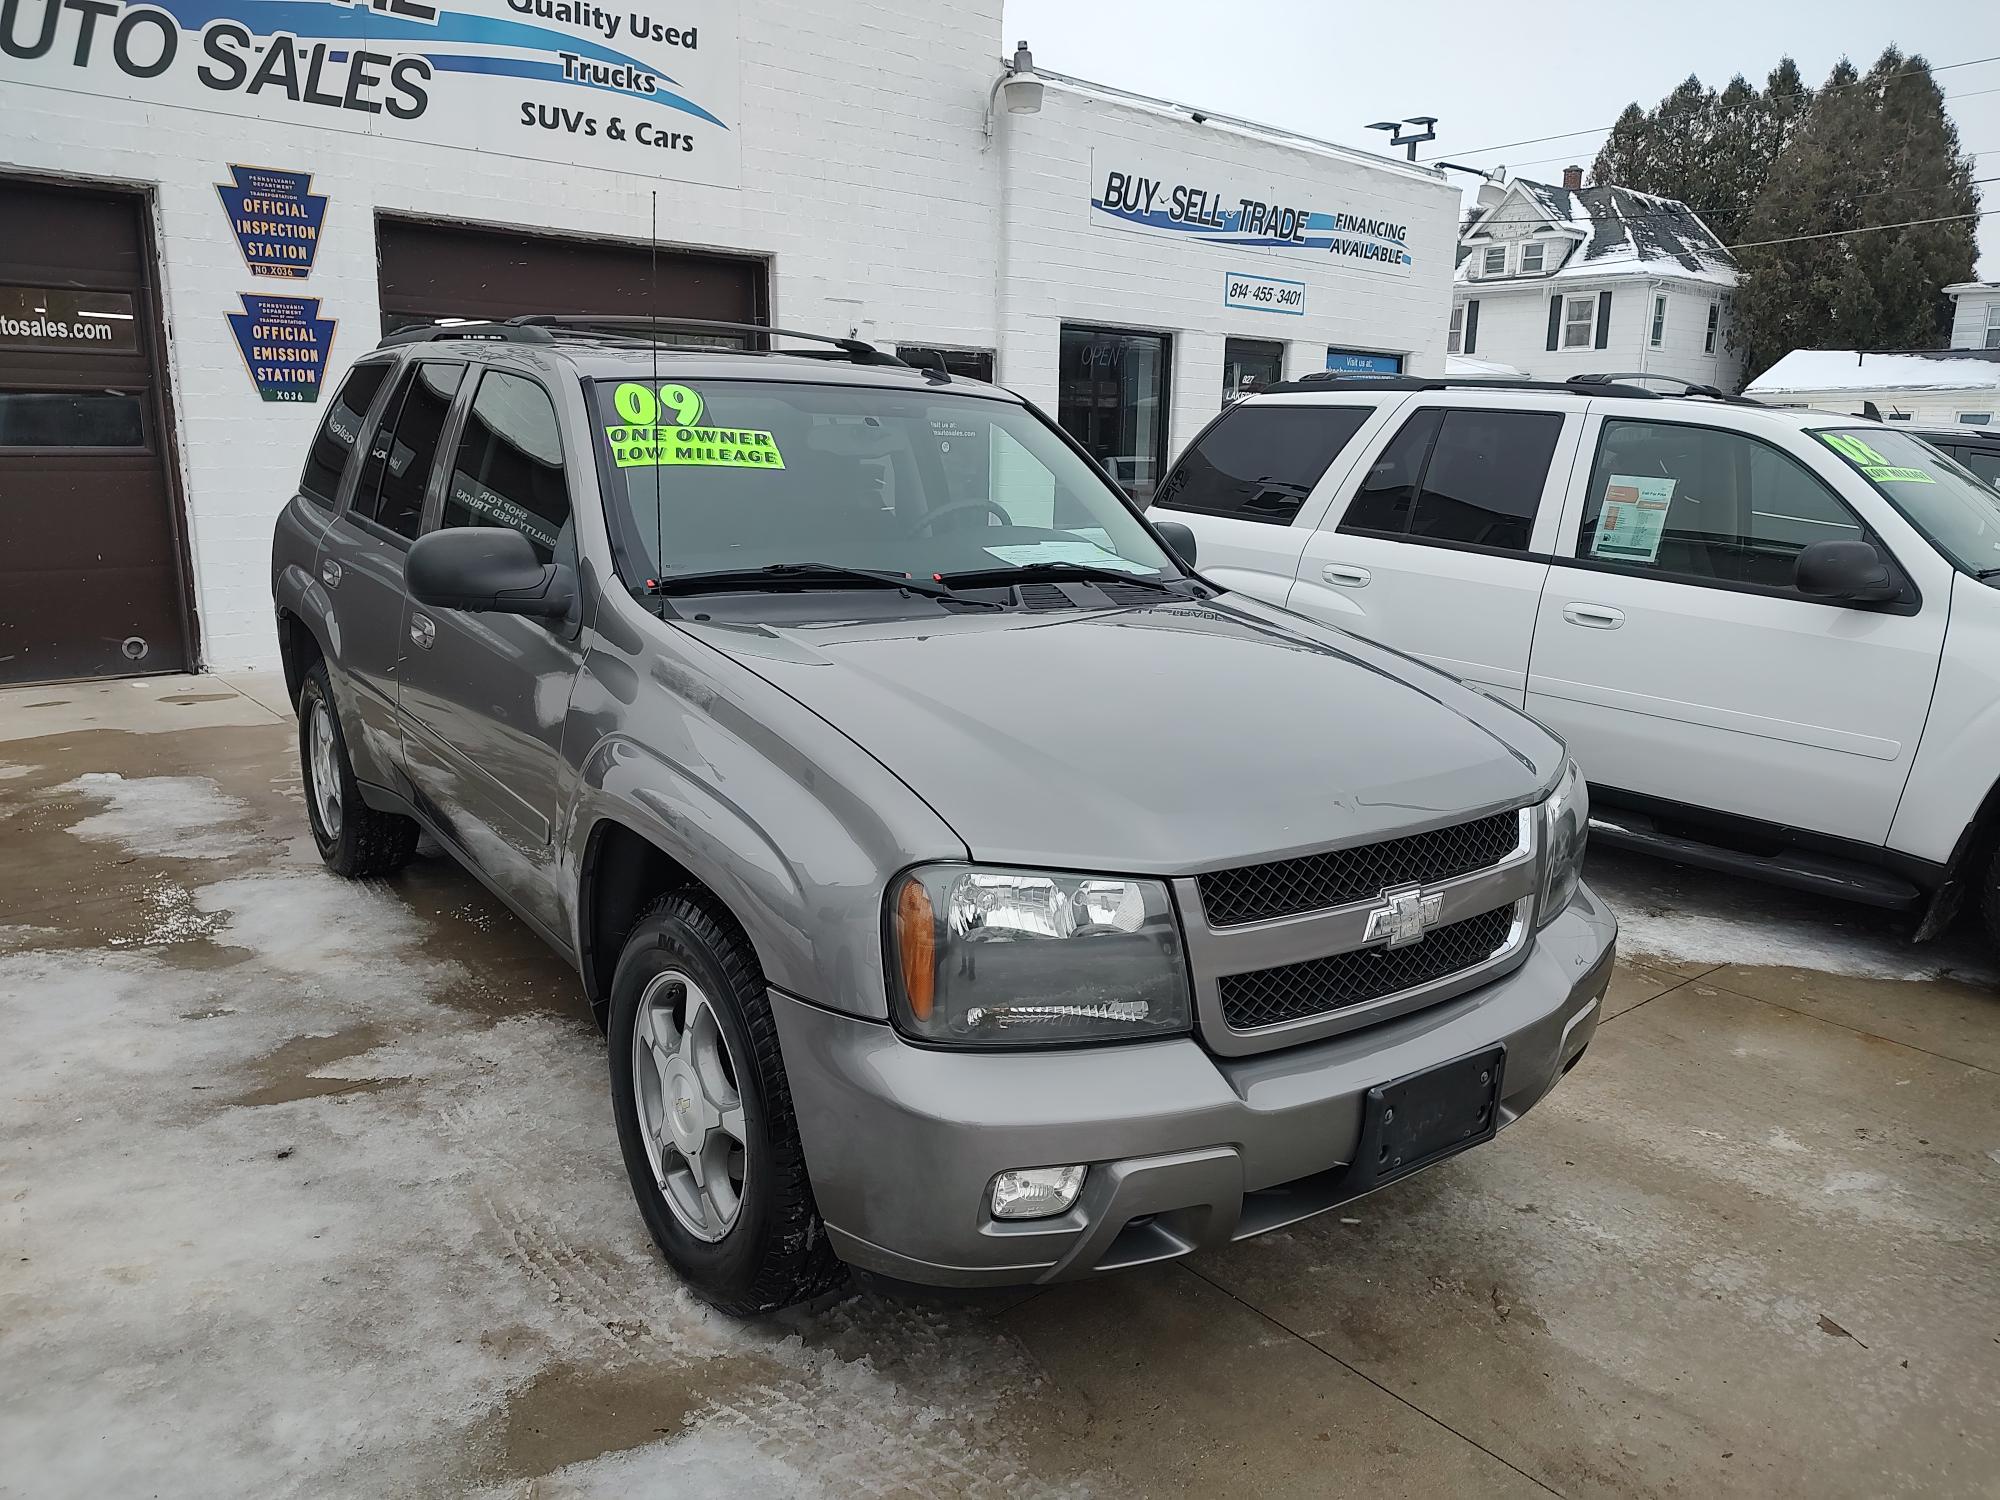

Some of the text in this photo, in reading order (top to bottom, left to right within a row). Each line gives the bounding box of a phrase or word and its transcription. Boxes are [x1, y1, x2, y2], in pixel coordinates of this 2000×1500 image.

[508, 0, 698, 49] Quality Used
[197, 23, 432, 120] SALES
[559, 53, 656, 93] Trucks
[520, 102, 694, 152] SUVs & Cars
[248, 175, 296, 185] PENNSYLVANIA
[252, 181, 293, 190] DEPARTMENT
[250, 190, 298, 201] TRANSPORTATION
[243, 198, 309, 219] OFFICIAL
[1104, 171, 1310, 243] BUY SELL TRADE
[236, 219, 316, 240] INSPECTION
[1334, 213, 1408, 242] FINANCING
[248, 241, 307, 261] STATION
[1328, 237, 1404, 265] AVAILABLE
[258, 302, 305, 311] PENNSYLVANIA
[262, 308, 302, 316] DEPARTMENT
[0, 315, 112, 340] tosales.com
[259, 317, 307, 326] TRANSPORTATION
[252, 325, 317, 342] OFFICIAL
[253, 346, 319, 363] EMISSION
[1081, 344, 1121, 367] OPEN
[1346, 357, 1357, 367] Visit
[257, 367, 316, 383] STATION
[1242, 375, 1255, 384] 827
[277, 390, 303, 401] X036
[614, 383, 704, 427] 09
[610, 429, 771, 447] ONE OWNER
[617, 447, 778, 463] LOW MILEAGE
